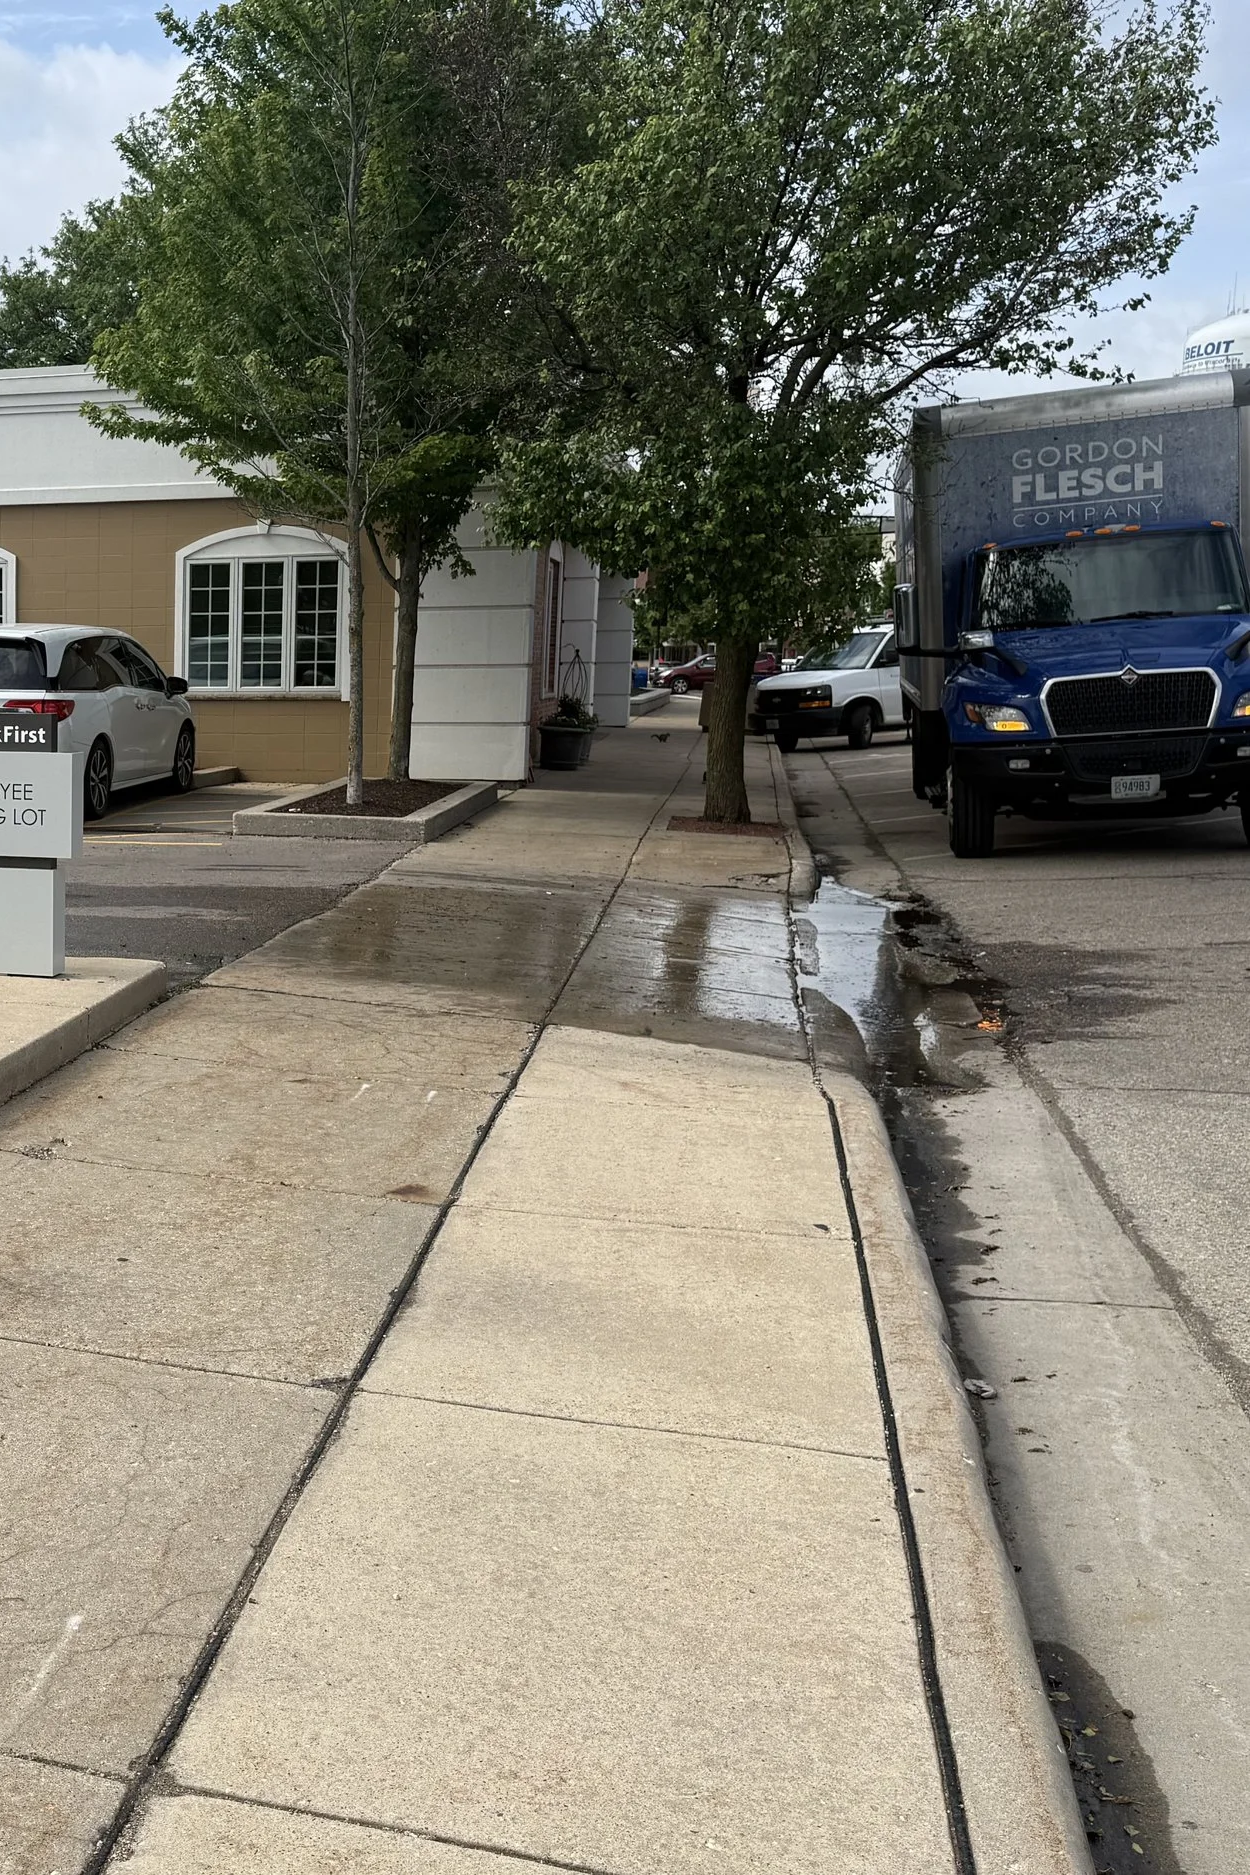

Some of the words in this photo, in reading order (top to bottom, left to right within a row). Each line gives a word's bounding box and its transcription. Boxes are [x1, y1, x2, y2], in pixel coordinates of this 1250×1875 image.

[1184, 339, 1235, 361] BELOIT
[1011, 434, 1163, 470] GORDON
[1011, 461, 1163, 503] FLESCH
[1012, 500, 1163, 528] COMPANY
[13, 808, 46, 826] LOT
